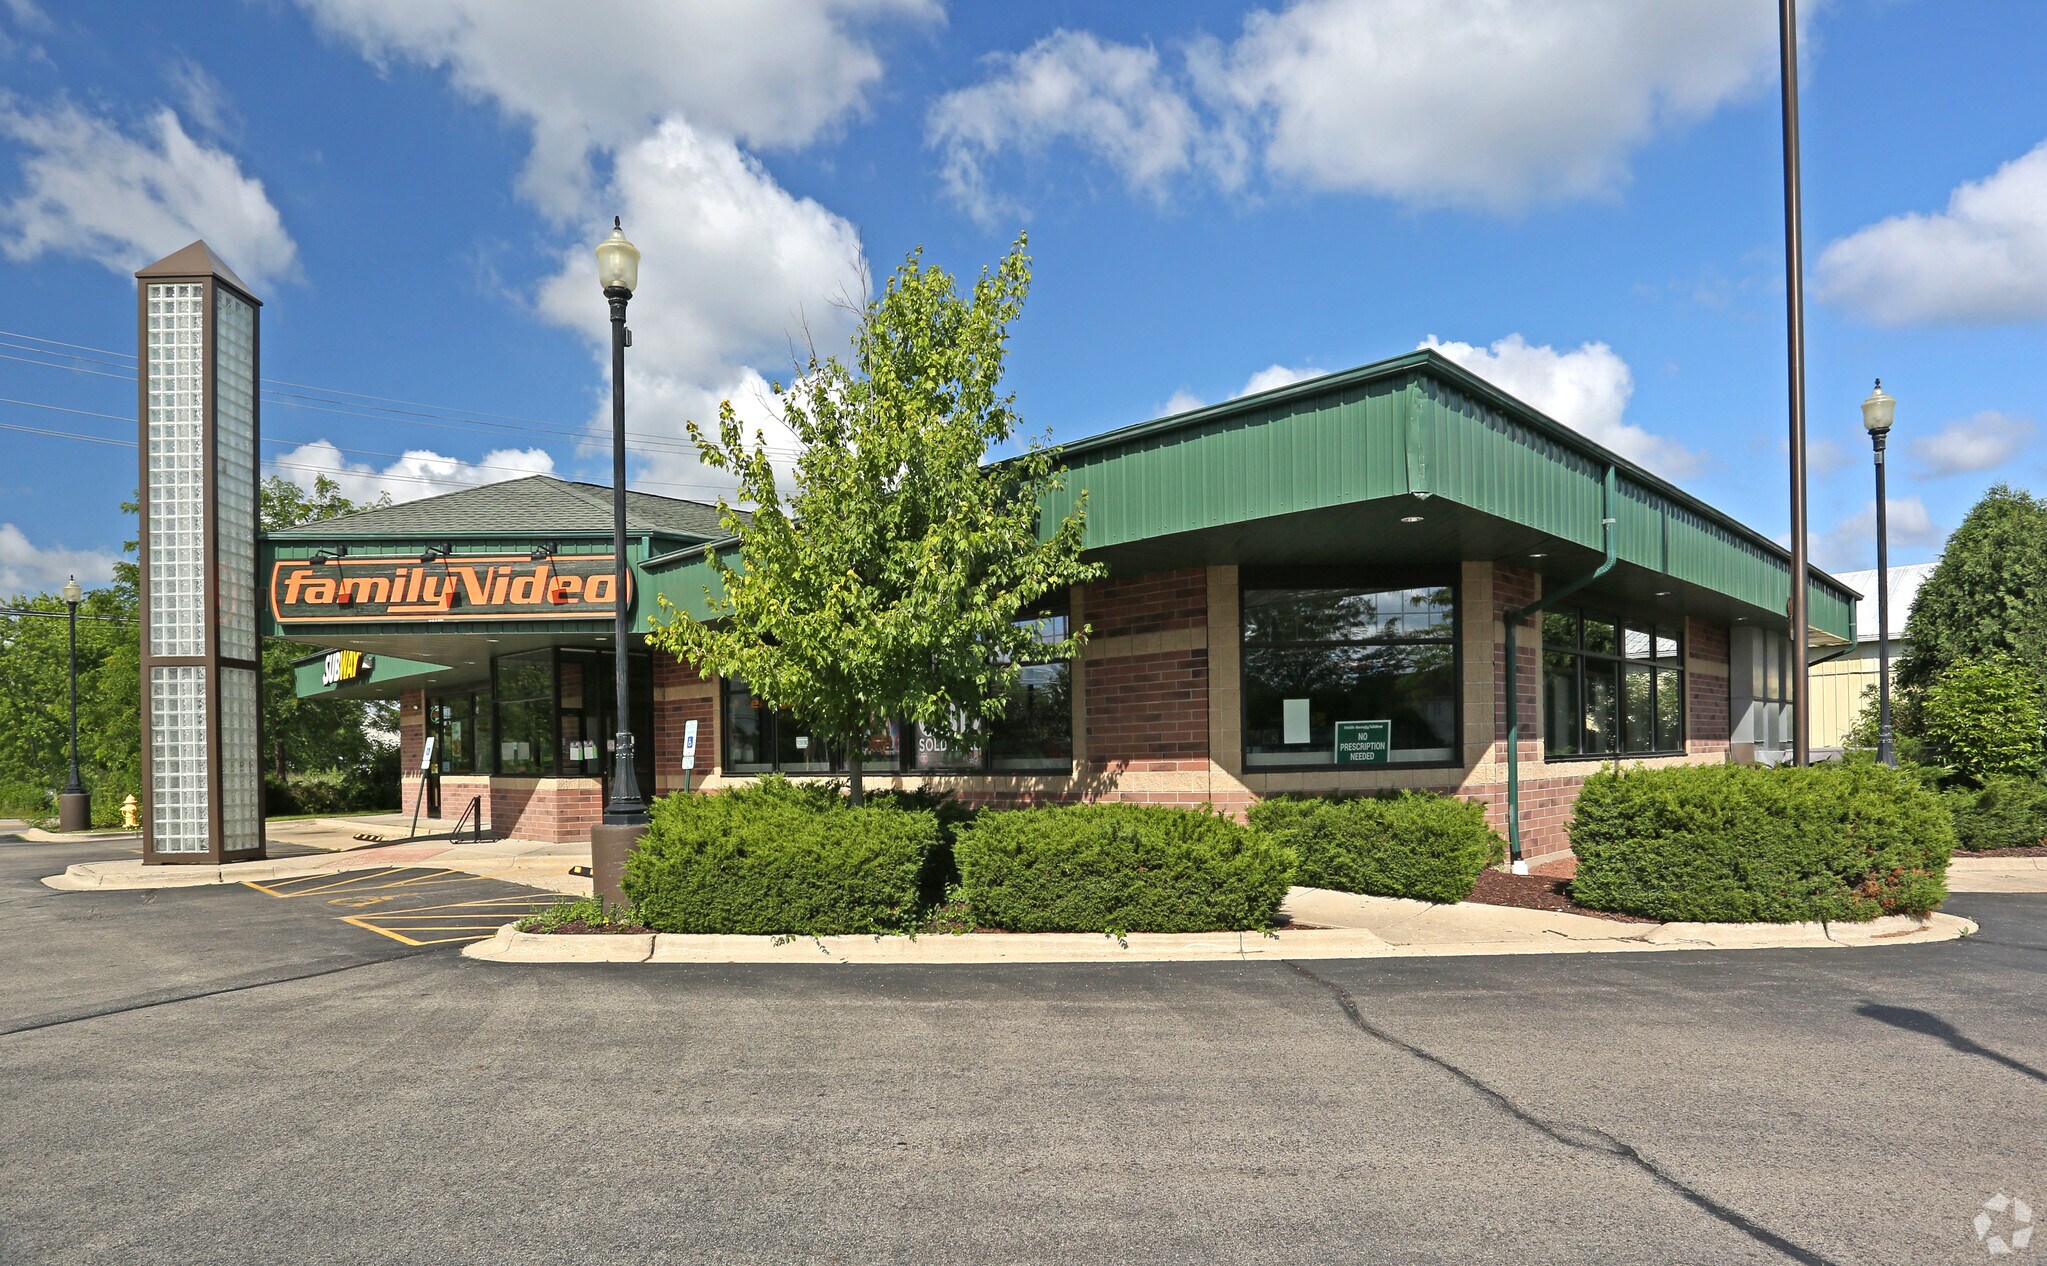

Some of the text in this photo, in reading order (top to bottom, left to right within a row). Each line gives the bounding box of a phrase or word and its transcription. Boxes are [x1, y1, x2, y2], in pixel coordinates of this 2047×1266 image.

[322, 650, 362, 685] SUBWAY
[1358, 732, 1368, 740] NO
[919, 738, 947, 752] SOLD
[1340, 742, 1385, 751] PRESCRIPTION
[1350, 752, 1375, 760] NEEDED
